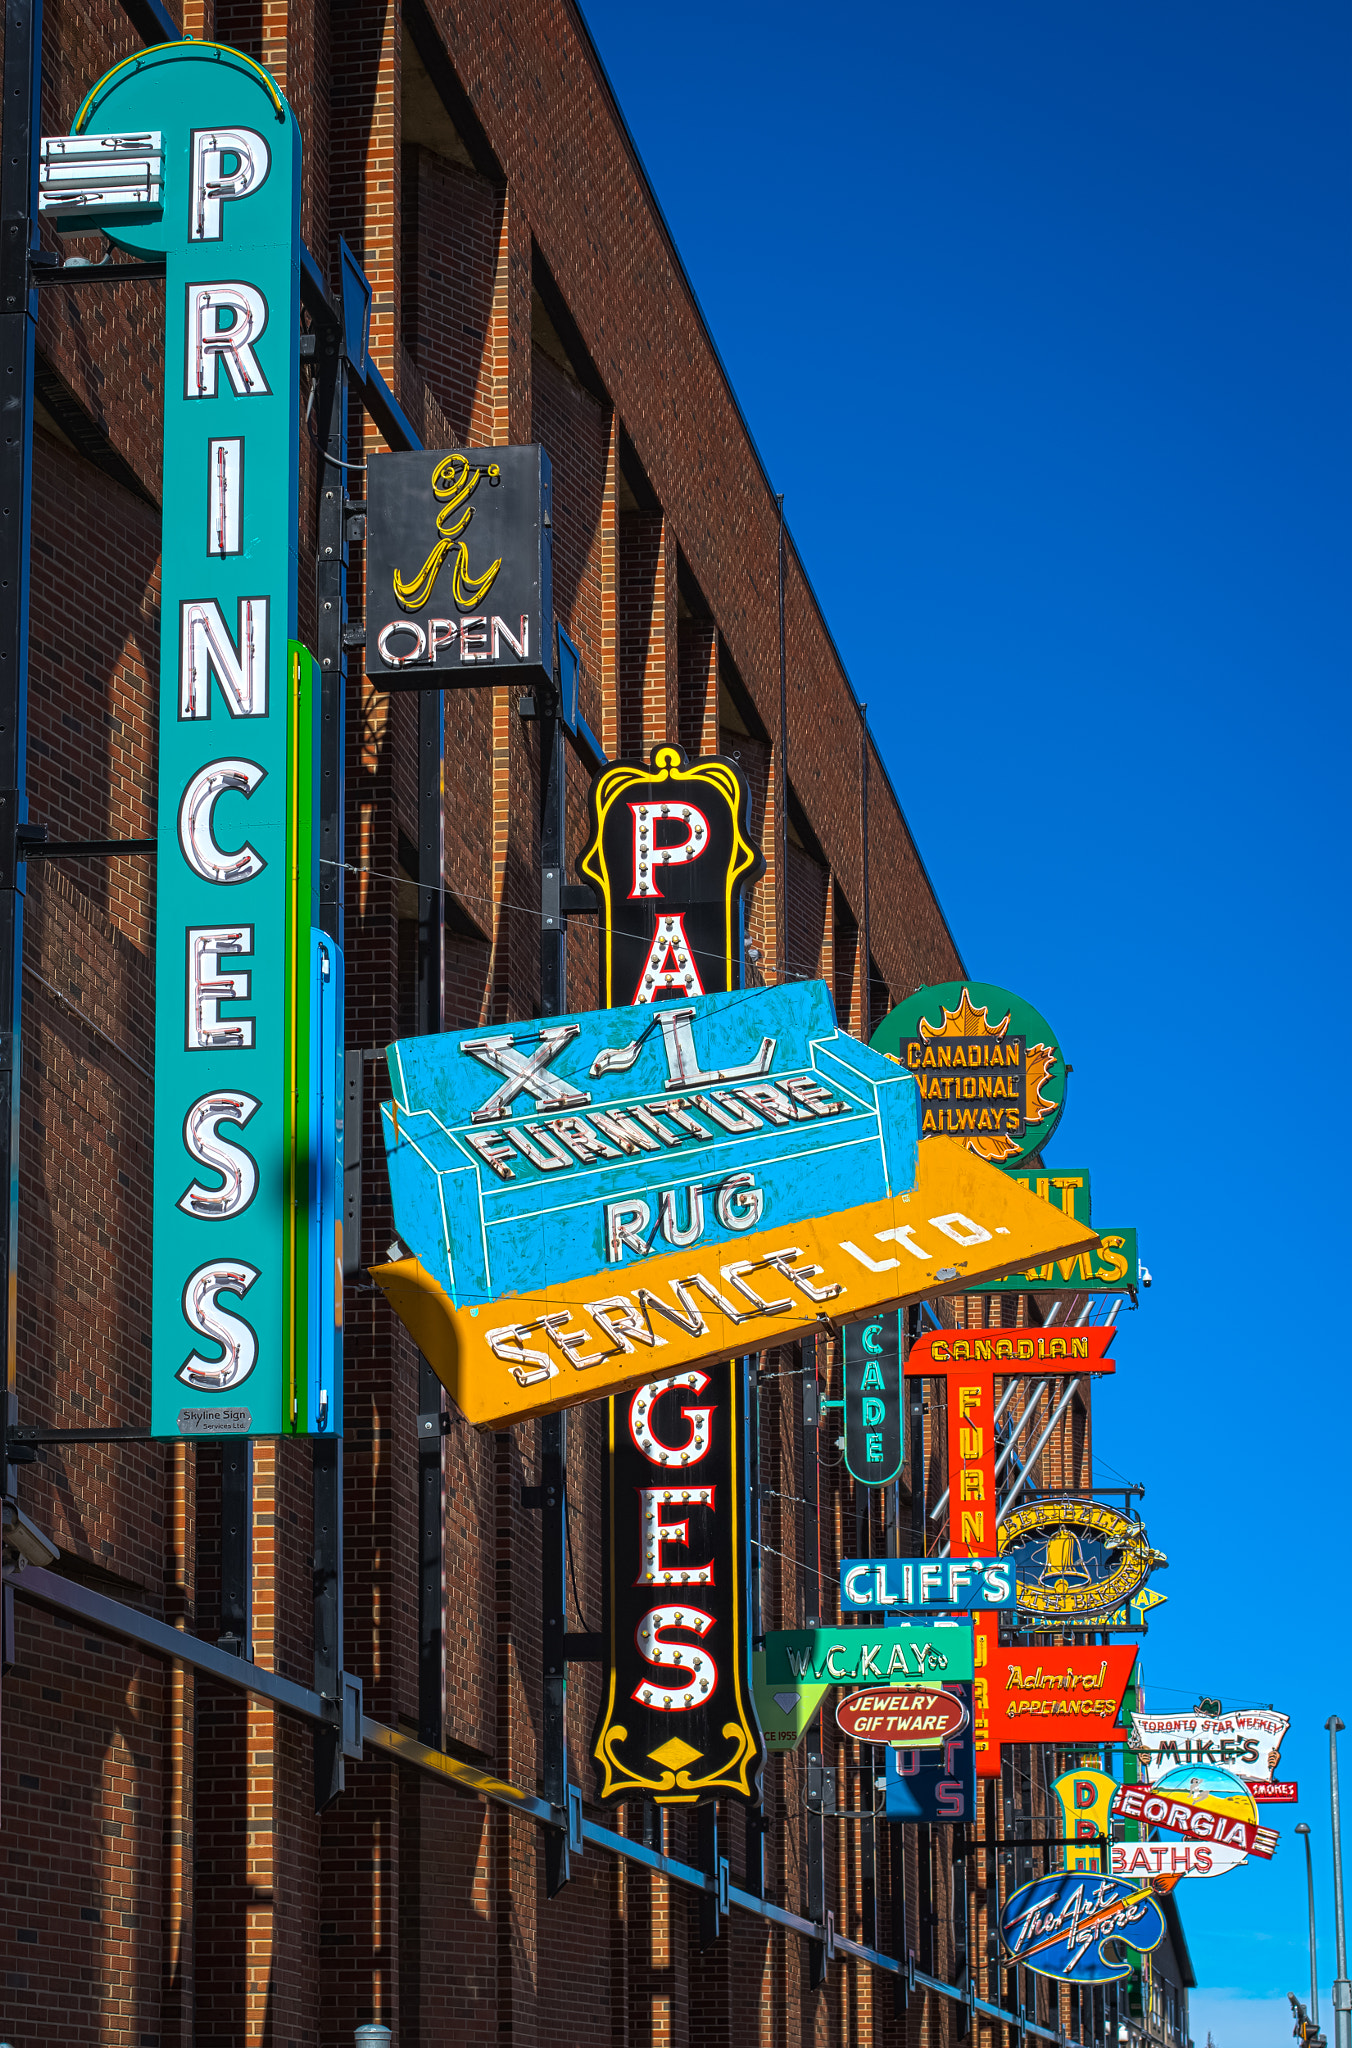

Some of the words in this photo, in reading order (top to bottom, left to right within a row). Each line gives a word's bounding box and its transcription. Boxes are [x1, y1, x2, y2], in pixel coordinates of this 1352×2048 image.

[376, 614, 531, 665] OPEN
[175, 126, 274, 1391] PRINCESS
[907, 1042, 1020, 1069] CANADIAN
[917, 1076, 1020, 1100] NATIONAL
[464, 1074, 852, 1181] FURNITURE
[922, 1107, 1020, 1132] AILWAYS
[606, 1172, 766, 1265] RUG
[484, 1247, 844, 1388] SERVICE
[838, 1211, 1012, 1274] LTD.
[931, 1336, 1090, 1361] CANADIAN
[861, 1314, 886, 1464] CADE
[183, 1410, 221, 1428] Skyline
[222, 1410, 246, 1421] Sign
[232, 1421, 246, 1429] Ltd.
[846, 1564, 1012, 1606] CLIFF'S
[1007, 1660, 1108, 1691] Admiral
[850, 1695, 940, 1712] JEWELRY
[1005, 1698, 1118, 1717] APPLIANCES
[778, 1731, 798, 1741] 1955
[1141, 1719, 1199, 1733] TORONTO
[1203, 1719, 1235, 1734] STAR
[1155, 1736, 1262, 1768] MIKE'S
[1252, 1783, 1296, 1796] SMOKES
[1112, 1846, 1214, 1874] BATHS
[1004, 1891, 1060, 1952] The
[1047, 1878, 1121, 1951] Art
